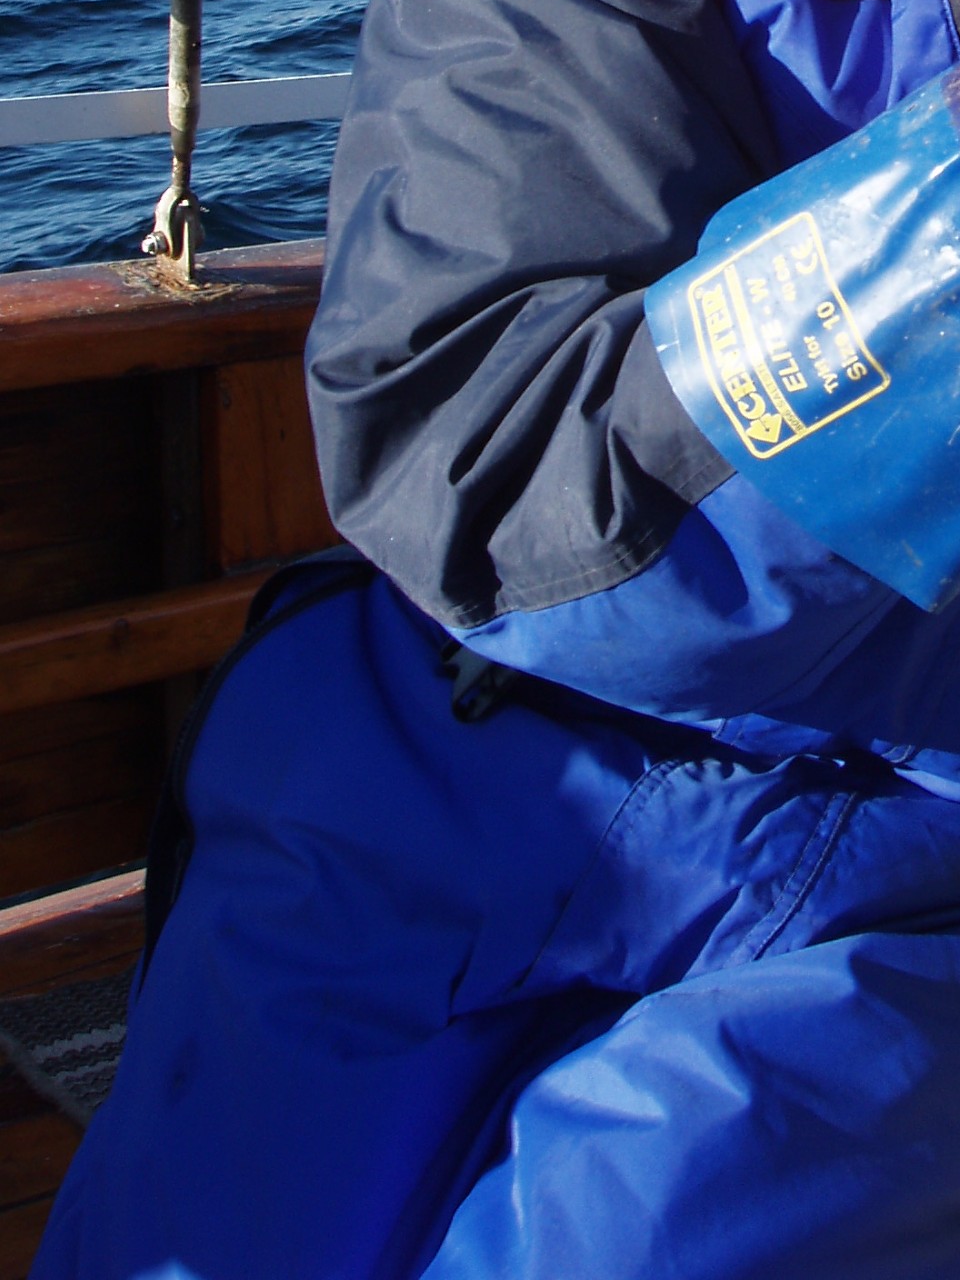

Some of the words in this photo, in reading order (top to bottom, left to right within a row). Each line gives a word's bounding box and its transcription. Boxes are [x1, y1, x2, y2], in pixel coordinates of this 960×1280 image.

[817, 301, 841, 329] 10
[701, 284, 766, 420] CENTER
[761, 319, 808, 392] ELITE
[836, 332, 868, 380] Size
